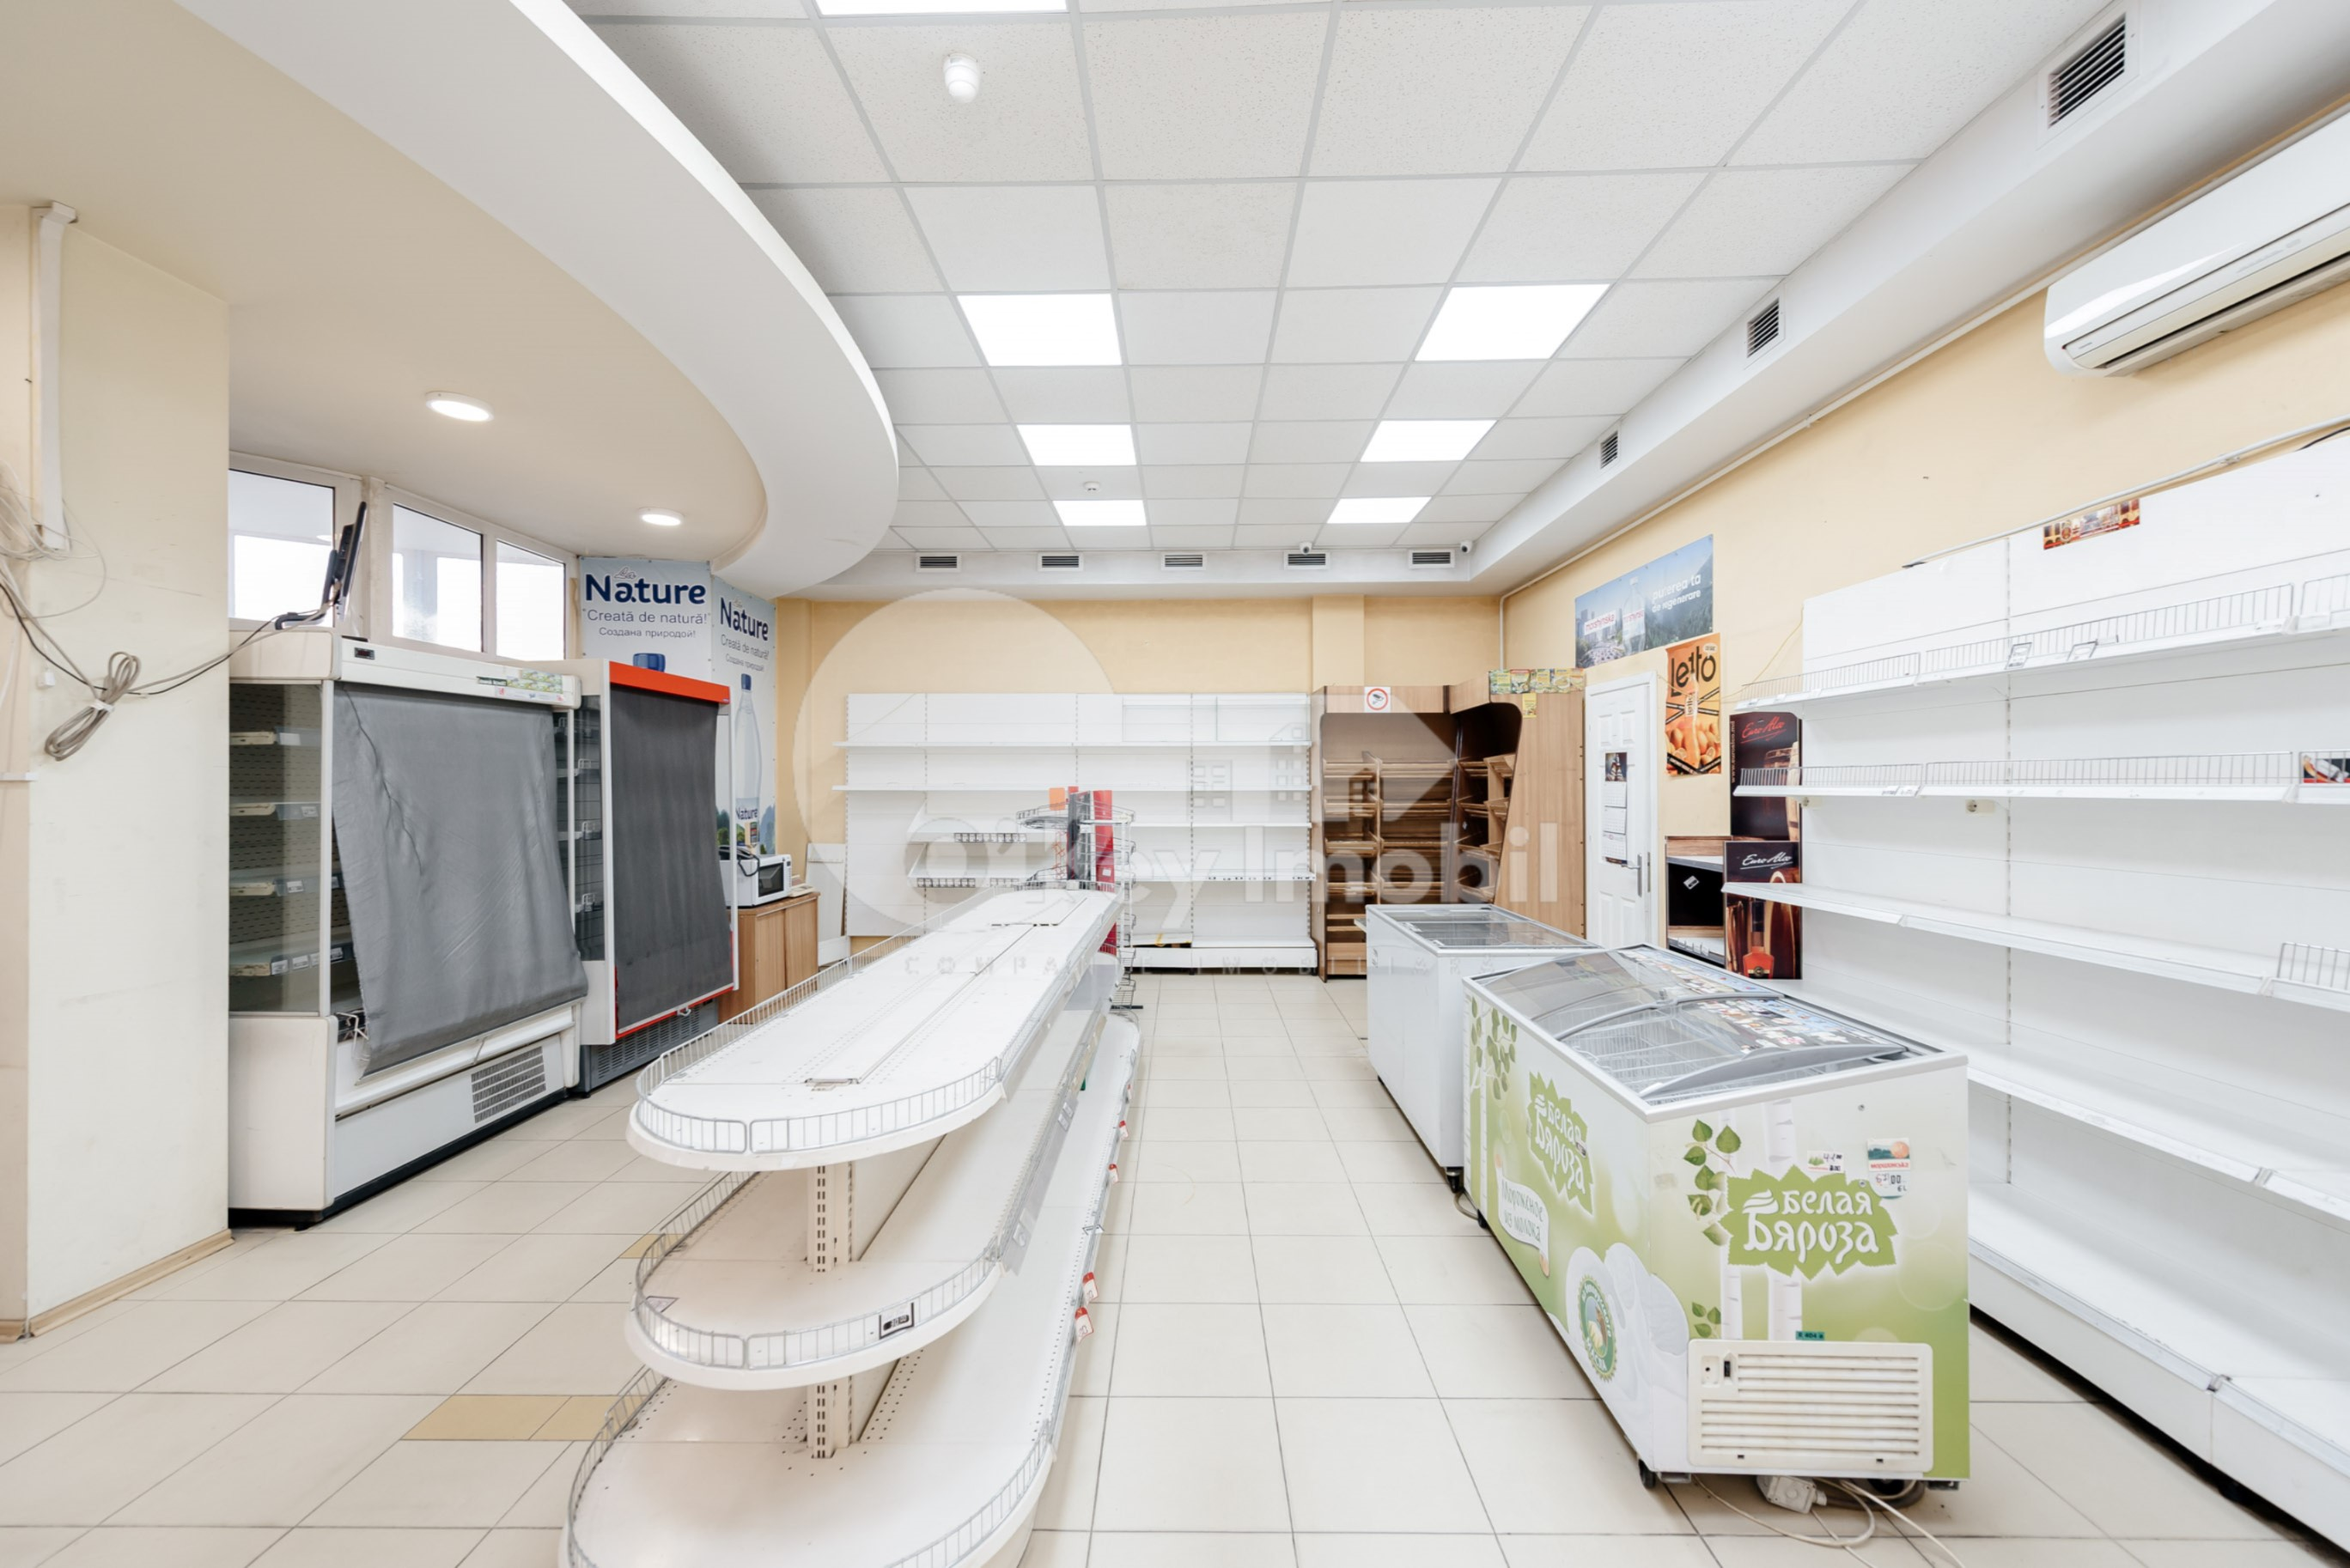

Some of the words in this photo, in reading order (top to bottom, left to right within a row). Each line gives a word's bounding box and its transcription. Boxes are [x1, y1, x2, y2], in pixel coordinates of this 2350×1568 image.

[586, 574, 707, 605] Nature
[1690, 574, 1702, 586] ta
[588, 609, 635, 622] Creată
[638, 611, 655, 623] de
[660, 613, 707, 624] natură!
[721, 597, 769, 641] Nature
[599, 627, 642, 637] Создана
[645, 629, 696, 639] природой!
[1742, 854, 1768, 866] Euro
[1781, 1190, 1873, 1215] Белая
[1742, 1212, 1879, 1264] Бяроза
